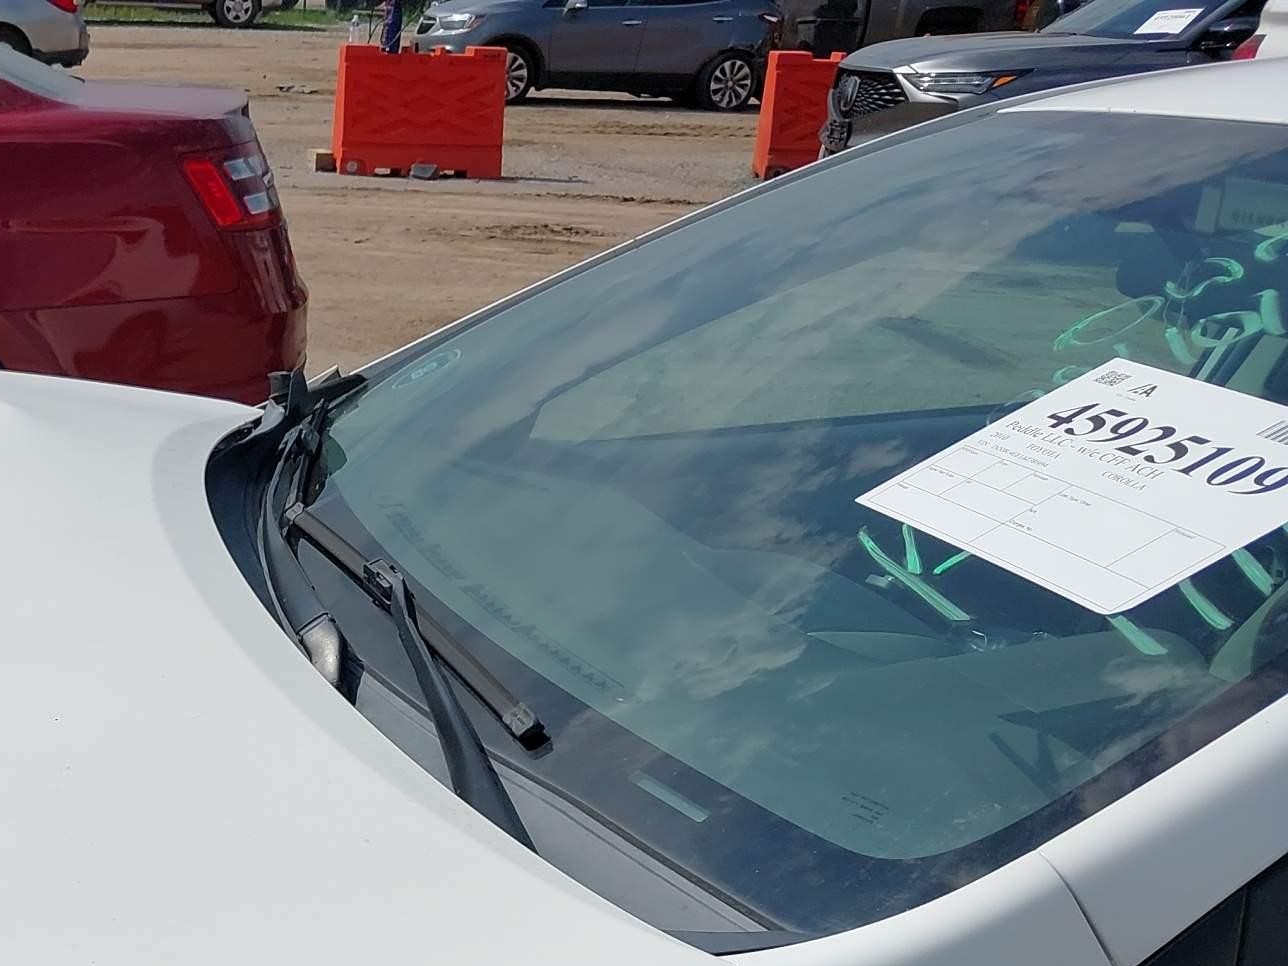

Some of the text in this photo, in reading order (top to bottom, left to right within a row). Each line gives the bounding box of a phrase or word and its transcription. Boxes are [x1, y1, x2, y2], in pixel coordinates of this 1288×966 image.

[1005, 420, 1044, 437] Peddle
[1041, 432, 1075, 448] LLC
[1125, 463, 1165, 480] ACH
[1026, 443, 1061, 459] TOYOTA
[1102, 471, 1147, 491] COROLLA
[1047, 403, 1288, 495] 45925109
